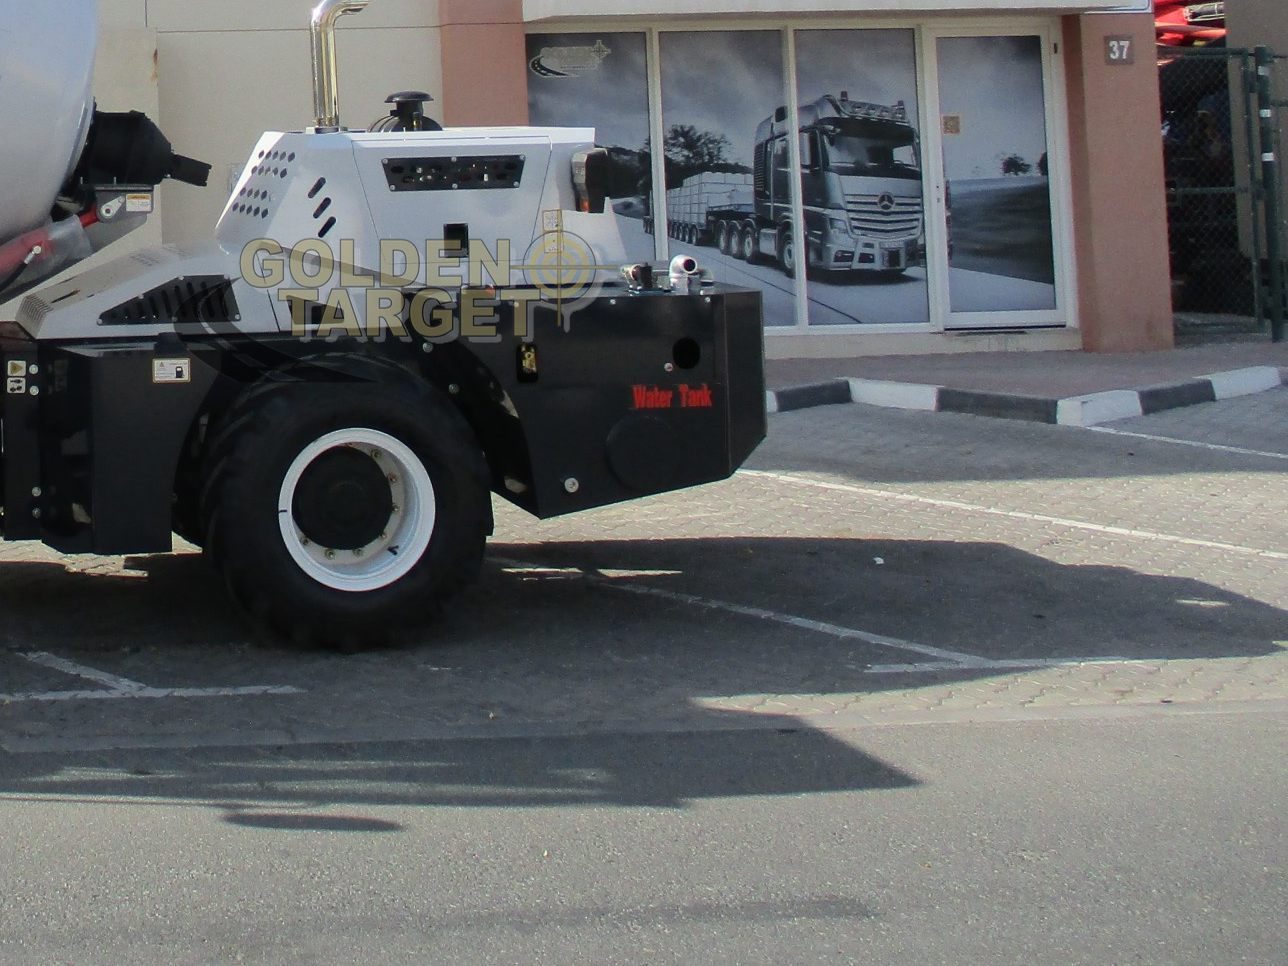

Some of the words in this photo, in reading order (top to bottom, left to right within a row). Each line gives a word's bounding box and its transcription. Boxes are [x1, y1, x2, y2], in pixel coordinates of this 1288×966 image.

[1109, 40, 1131, 60] 37
[632, 384, 673, 409] Water
[678, 383, 712, 408] Tank
